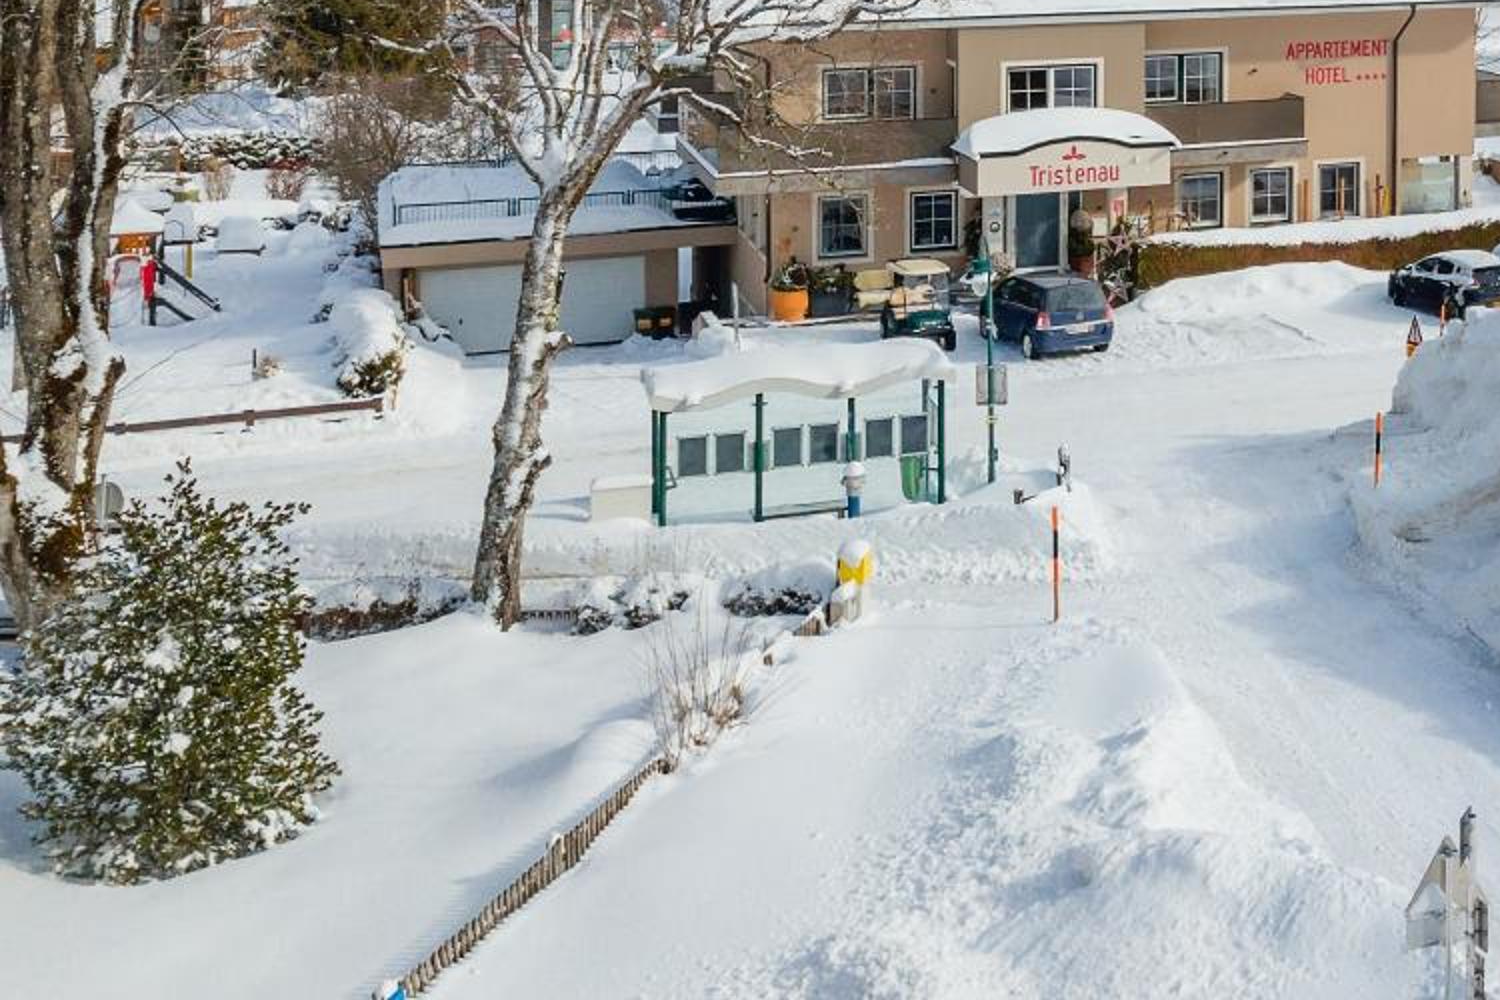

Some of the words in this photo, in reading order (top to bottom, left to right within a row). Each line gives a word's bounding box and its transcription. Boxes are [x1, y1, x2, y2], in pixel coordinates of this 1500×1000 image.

[1285, 39, 1389, 60] APPARTEMENT
[1305, 66, 1351, 85] HOTEL
[1029, 163, 1120, 186] Tristenau
